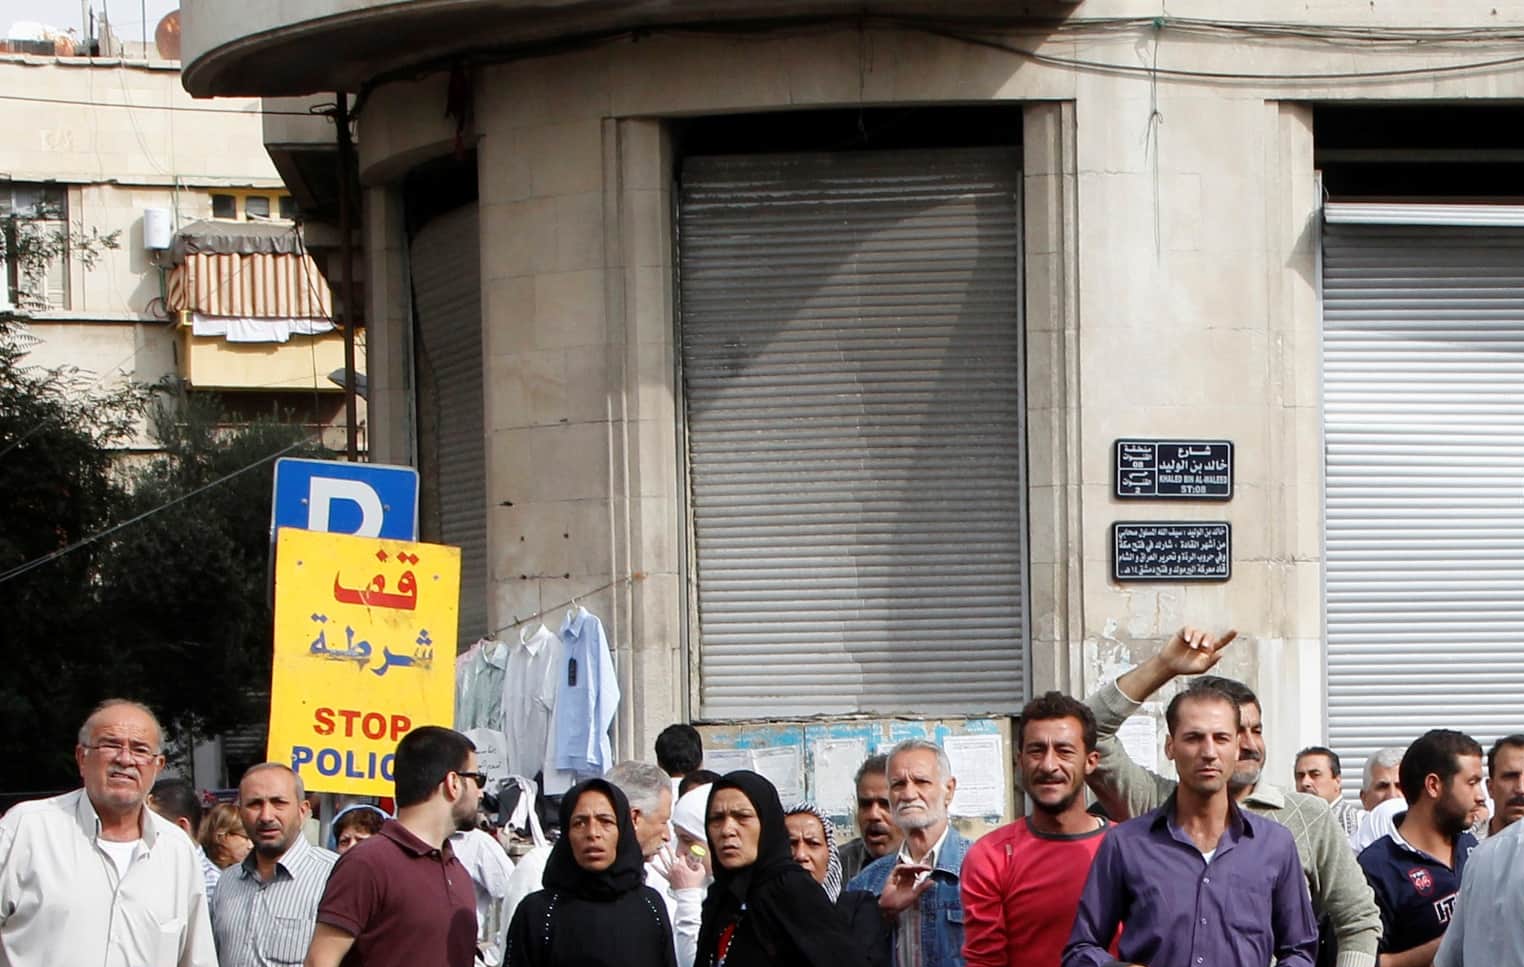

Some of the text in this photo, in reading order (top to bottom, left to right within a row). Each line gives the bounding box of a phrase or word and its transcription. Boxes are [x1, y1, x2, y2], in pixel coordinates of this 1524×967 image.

[1160, 459, 1227, 473] خالد بن الوليد
[1178, 446, 1211, 458] شارع
[1160, 475, 1182, 483] KHALED
[334, 549, 419, 611] قف
[310, 613, 433, 677] شرطة
[313, 707, 411, 742] STOP
[291, 746, 395, 782] POLIC
